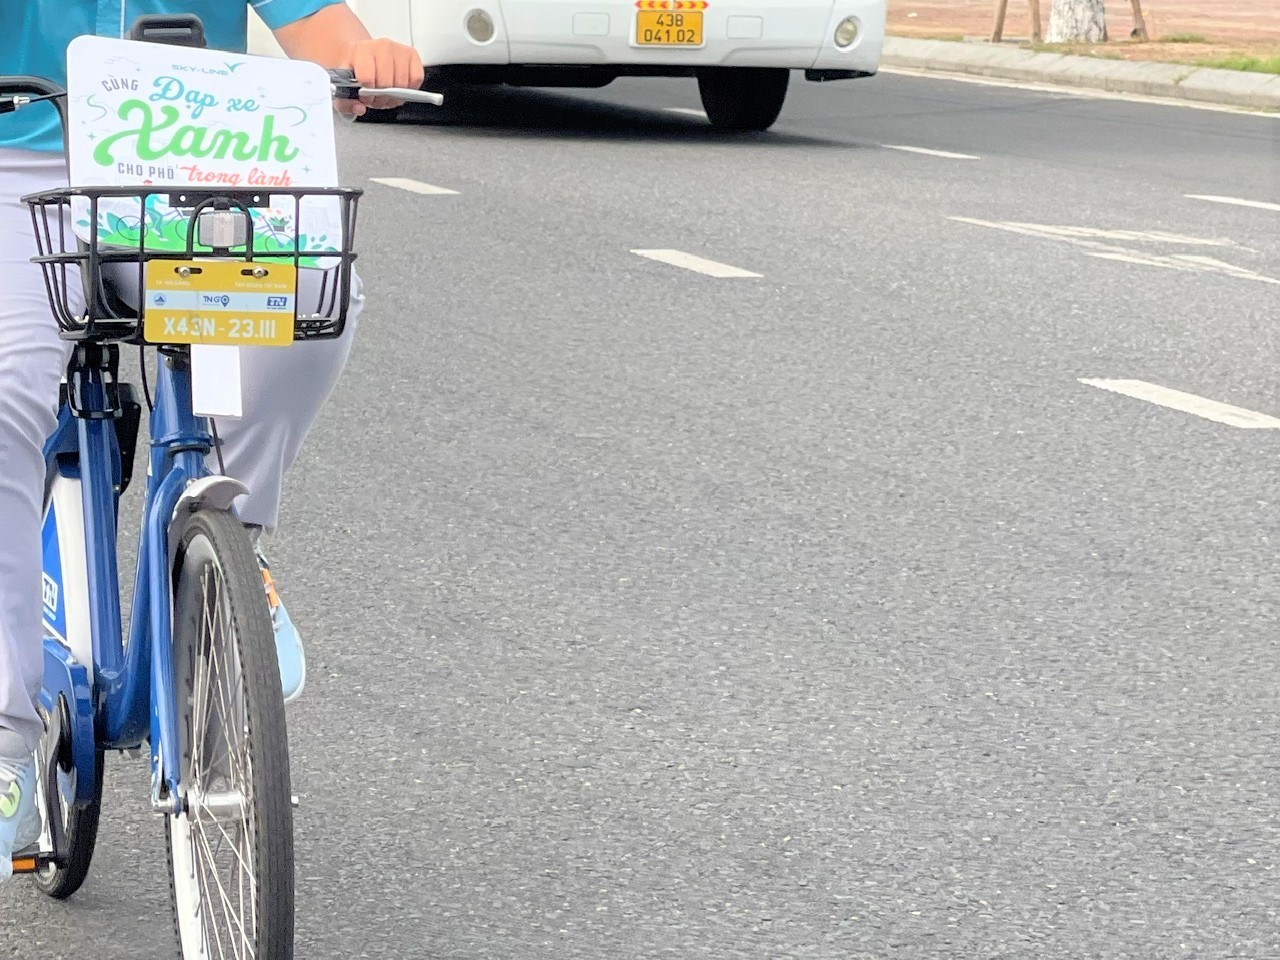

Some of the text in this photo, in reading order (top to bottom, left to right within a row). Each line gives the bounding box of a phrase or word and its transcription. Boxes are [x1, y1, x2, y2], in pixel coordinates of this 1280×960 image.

[656, 13, 684, 27] 43B
[644, 29, 695, 43] 041.02
[171, 64, 229, 76] SKY-LINE
[101, 74, 260, 120] CÙNG Đạp xe
[93, 98, 300, 167] Xanh
[117, 162, 144, 177] CHO
[179, 165, 243, 187] trong
[247, 168, 293, 187] lành
